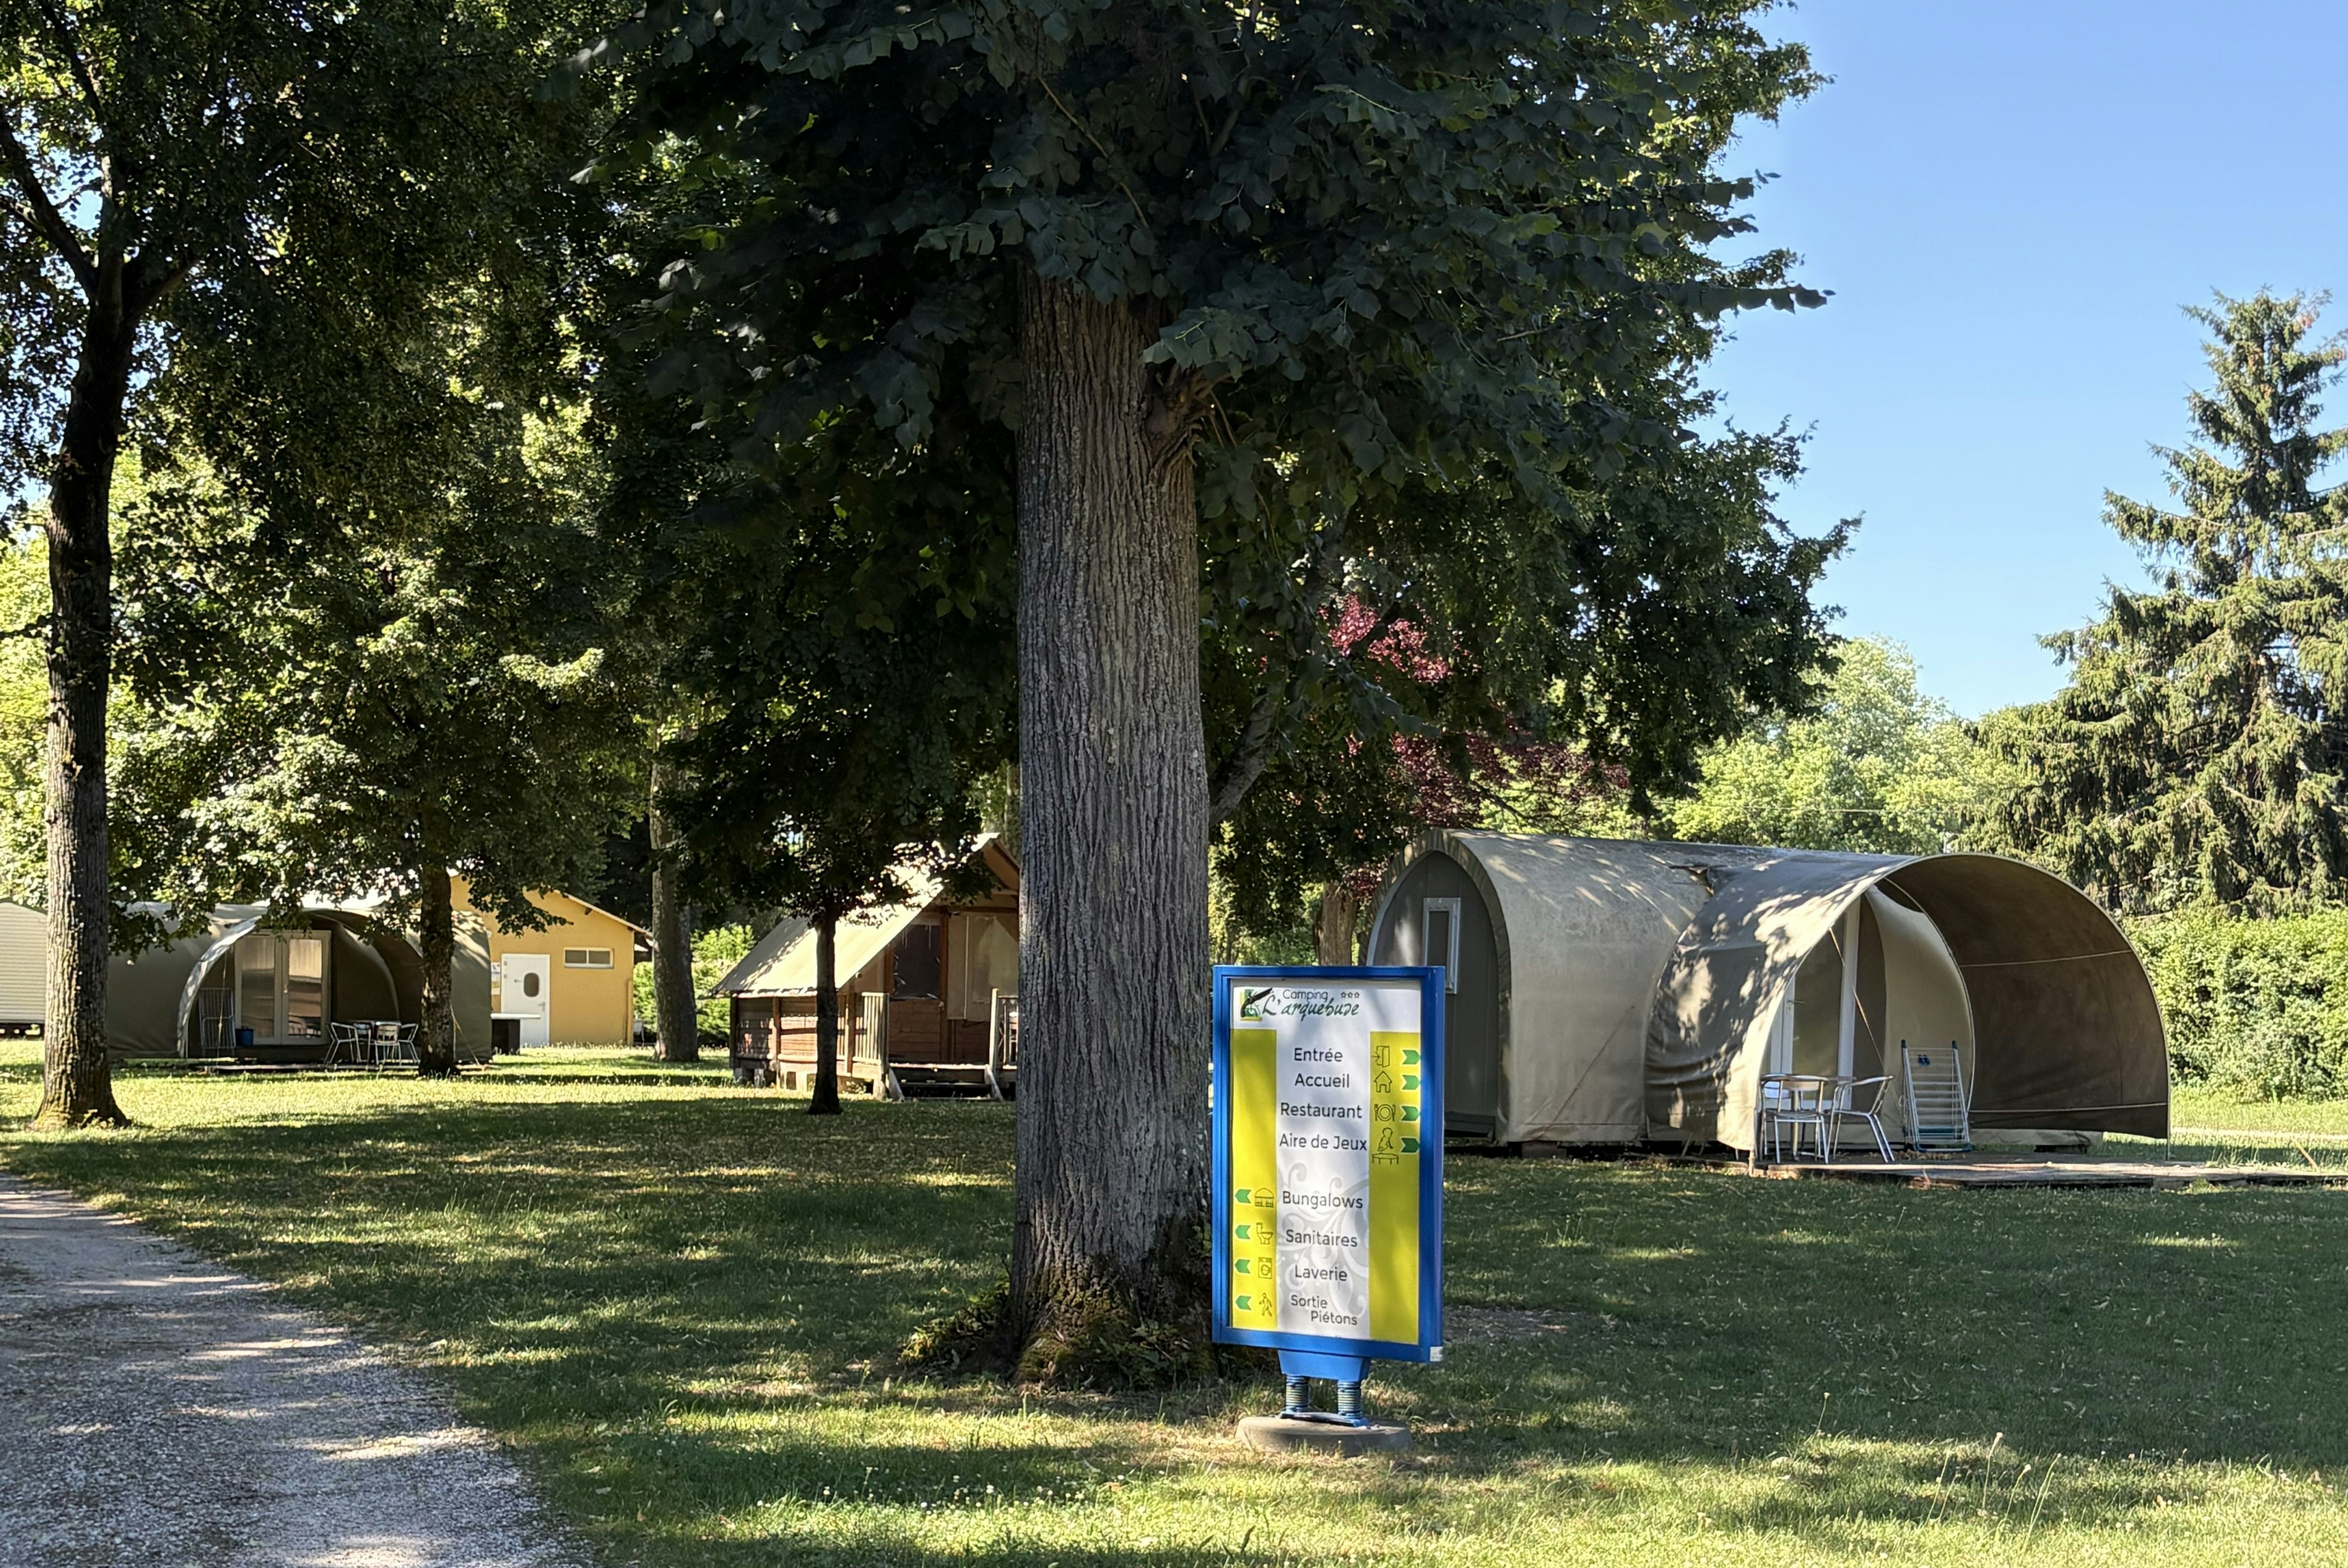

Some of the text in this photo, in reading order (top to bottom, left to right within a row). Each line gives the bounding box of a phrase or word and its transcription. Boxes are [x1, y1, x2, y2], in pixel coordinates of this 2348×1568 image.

[1283, 989, 1329, 1002] Camping
[1294, 1047, 1343, 1062] Entrée
[1294, 1073, 1350, 1088] Accueil
[1280, 1102, 1363, 1119] Restaurant
[1279, 1133, 1367, 1151] Aire de Jeux
[1283, 1190, 1364, 1209] Bungalows
[1285, 1229, 1358, 1247] Sanitaires
[1295, 1266, 1348, 1281] Laverie
[1291, 1295, 1328, 1309] Sortie
[1310, 1310, 1358, 1326] Piétons
